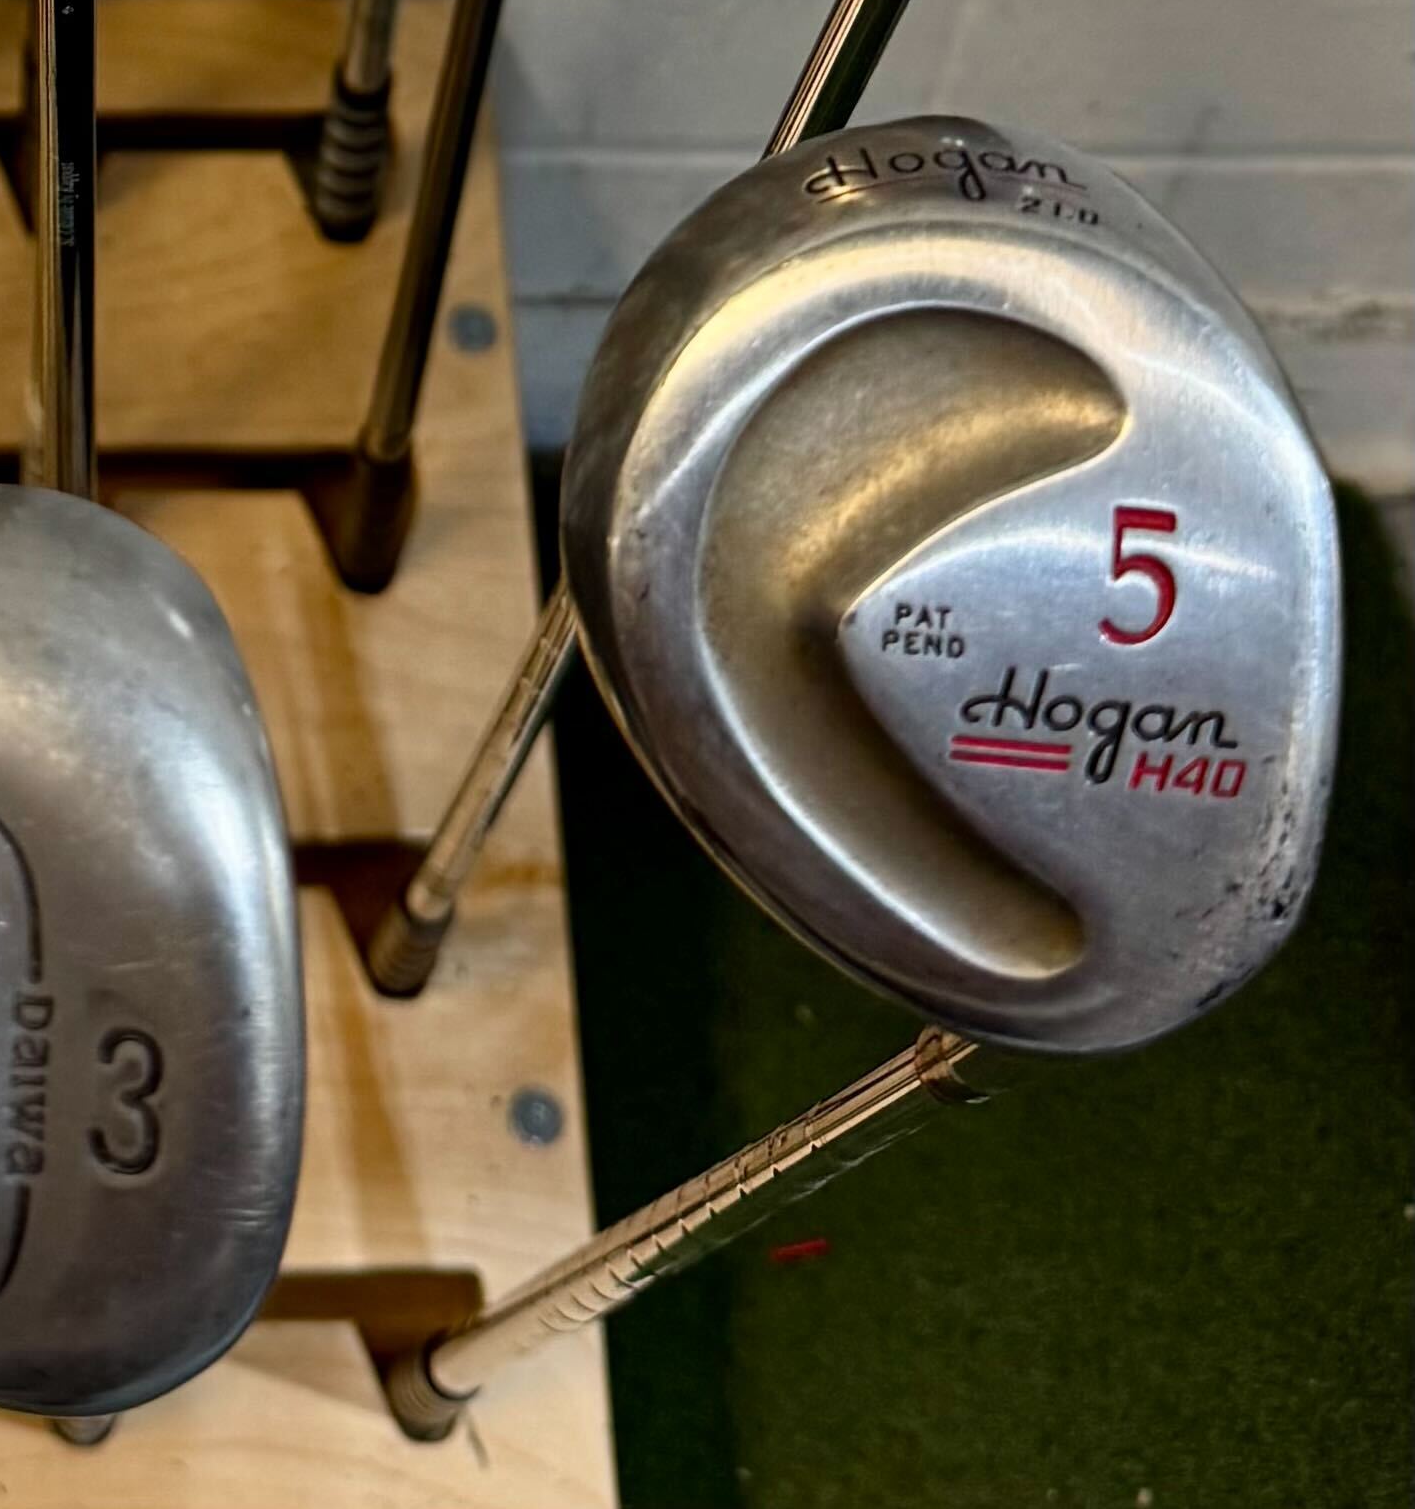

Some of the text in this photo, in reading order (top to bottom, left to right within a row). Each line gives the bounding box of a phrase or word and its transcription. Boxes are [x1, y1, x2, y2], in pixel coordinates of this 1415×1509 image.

[803, 145, 1086, 201] Hogan
[1099, 506, 1178, 646] 5
[881, 629, 966, 661] PEND
[894, 604, 952, 630] PAT
[959, 666, 1238, 784] Hogan
[1128, 751, 1247, 800] H40
[89, 1027, 165, 1175] 3
